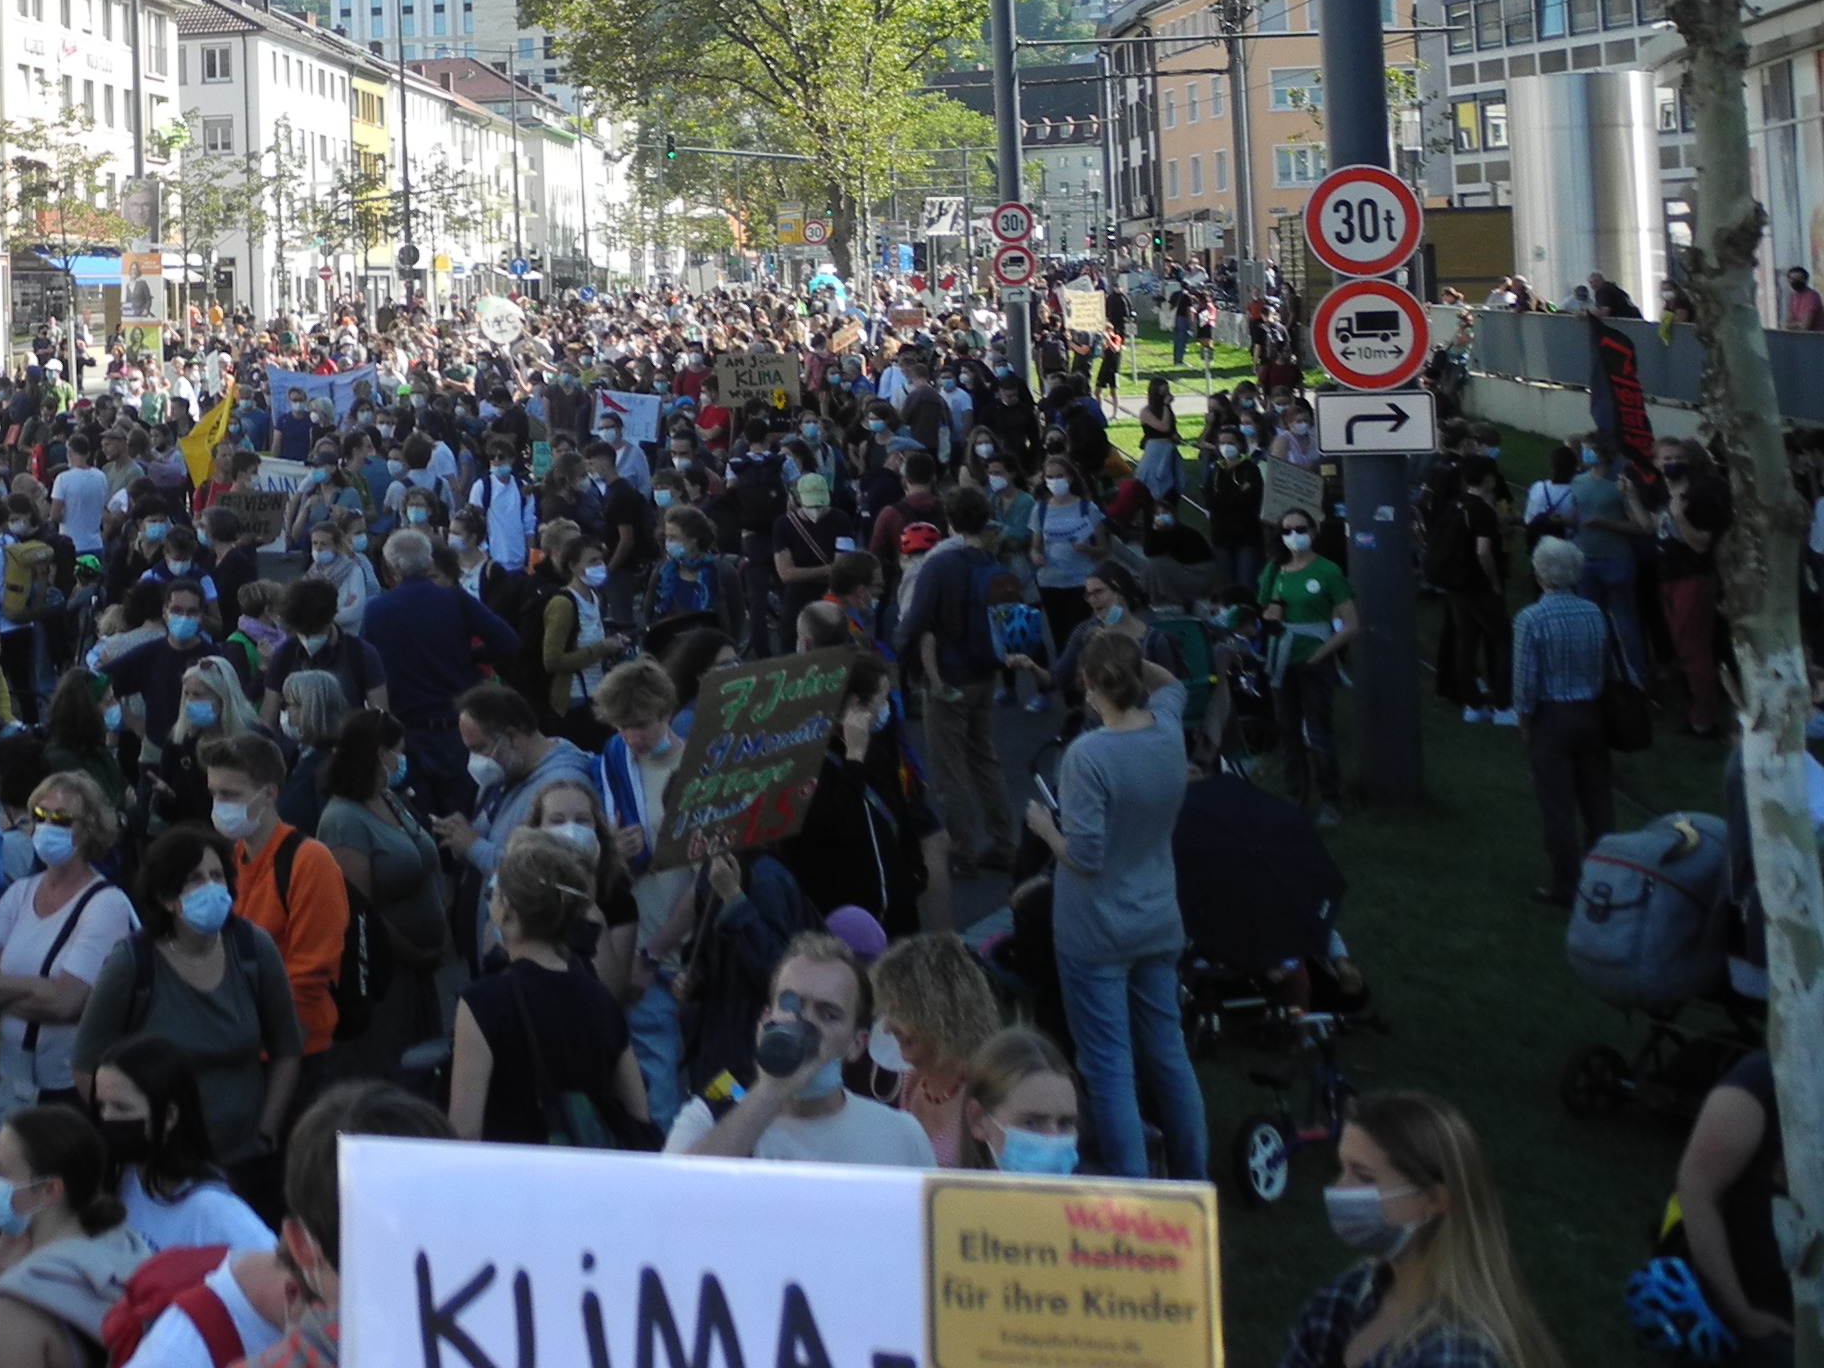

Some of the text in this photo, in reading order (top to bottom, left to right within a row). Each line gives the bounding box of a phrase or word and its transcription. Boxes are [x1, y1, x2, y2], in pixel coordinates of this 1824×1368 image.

[807, 225, 823, 239] 30
[1357, 346, 1389, 360] 10m
[734, 368, 785, 388] KLIMA
[720, 663, 848, 730] 7 Jahre
[699, 709, 833, 776] 9 Monate
[722, 758, 795, 798] Tage
[959, 1229, 1182, 1275] Eltern haften
[941, 1275, 1196, 1324] für ihre Kinder
